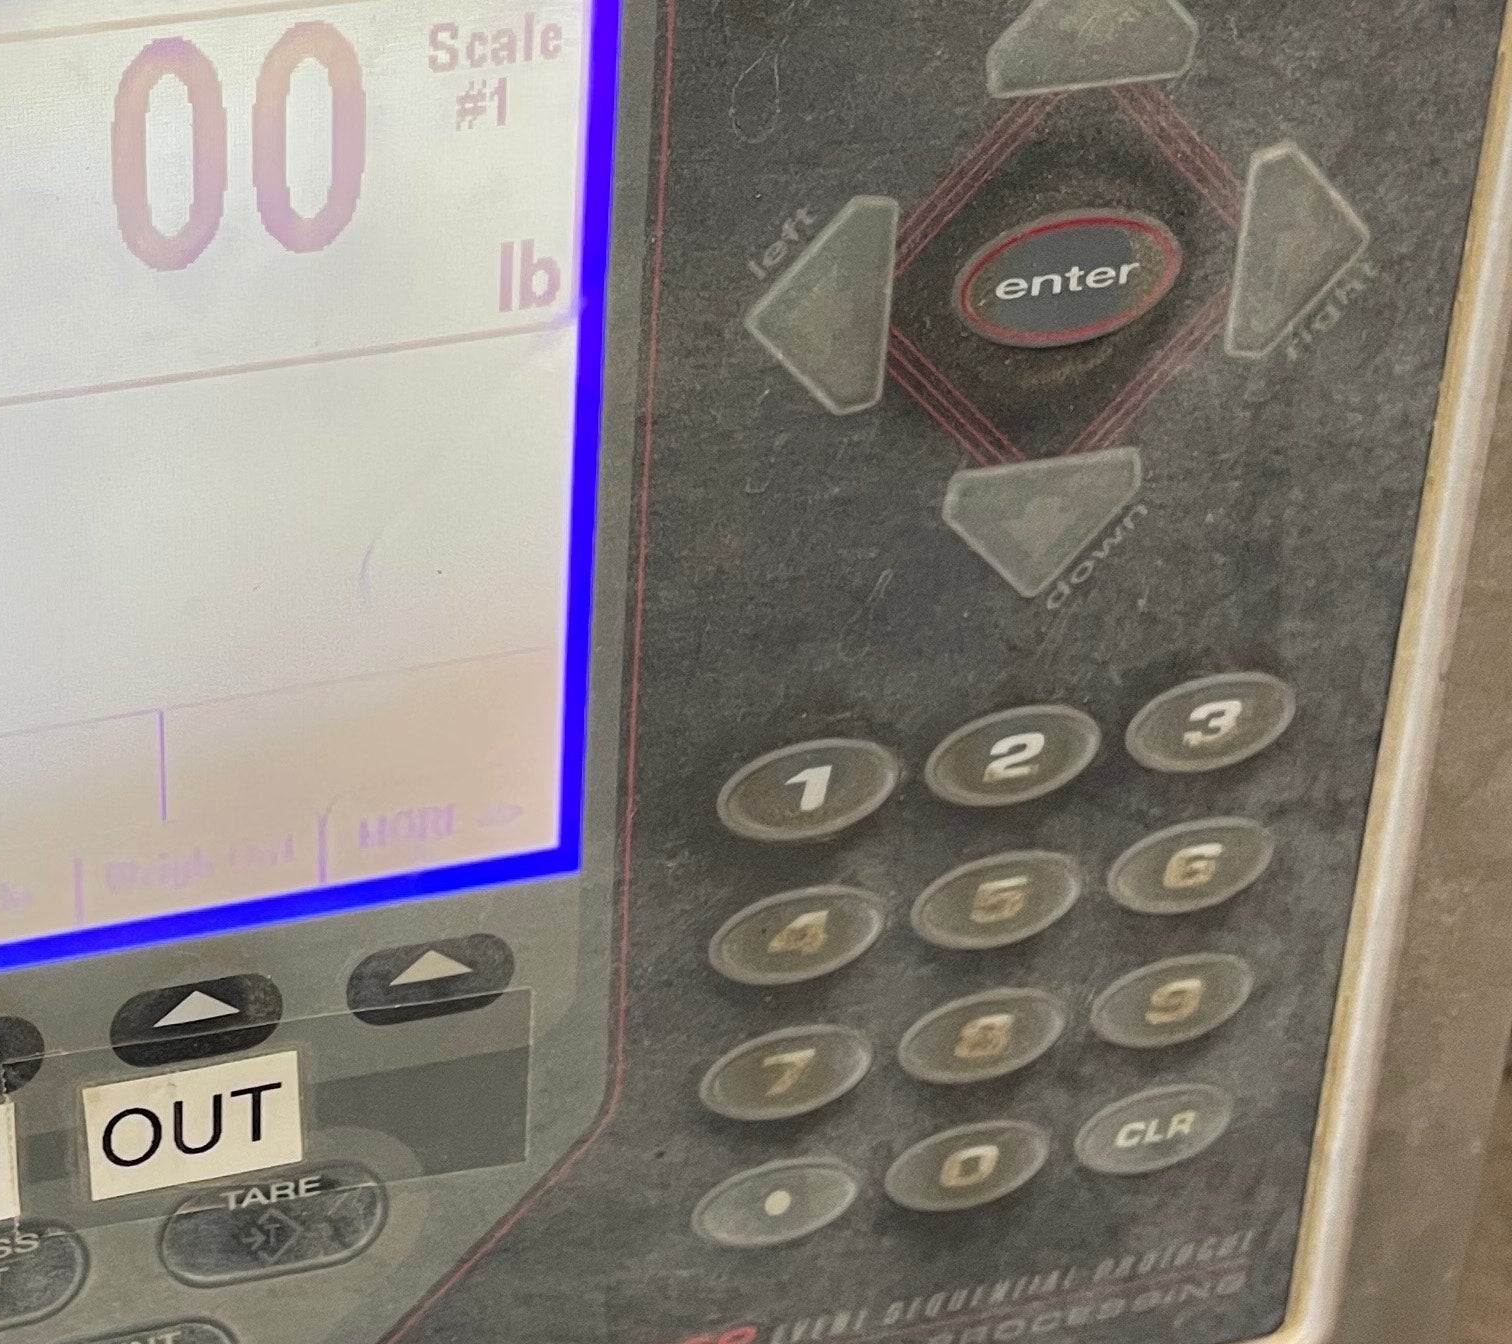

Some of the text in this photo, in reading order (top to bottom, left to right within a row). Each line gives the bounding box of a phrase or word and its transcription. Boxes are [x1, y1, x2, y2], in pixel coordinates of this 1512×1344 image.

[428, 12, 563, 74] Scale
[455, 77, 509, 131] #1
[111, 19, 367, 273] 00
[498, 238, 562, 314] lb
[995, 258, 1141, 302] enter
[1182, 698, 1244, 748] 3
[982, 731, 1046, 783] 2
[785, 764, 834, 812] 1
[1161, 842, 1224, 890] 6
[969, 875, 1030, 925] 5
[766, 909, 830, 955] 4
[1143, 977, 1204, 1026] 9
[761, 1047, 817, 1098] 7
[101, 1081, 283, 1168] OUT
[1114, 1109, 1199, 1150] CLR
[938, 1143, 1001, 1188] 0
[218, 1175, 323, 1212] TARE
